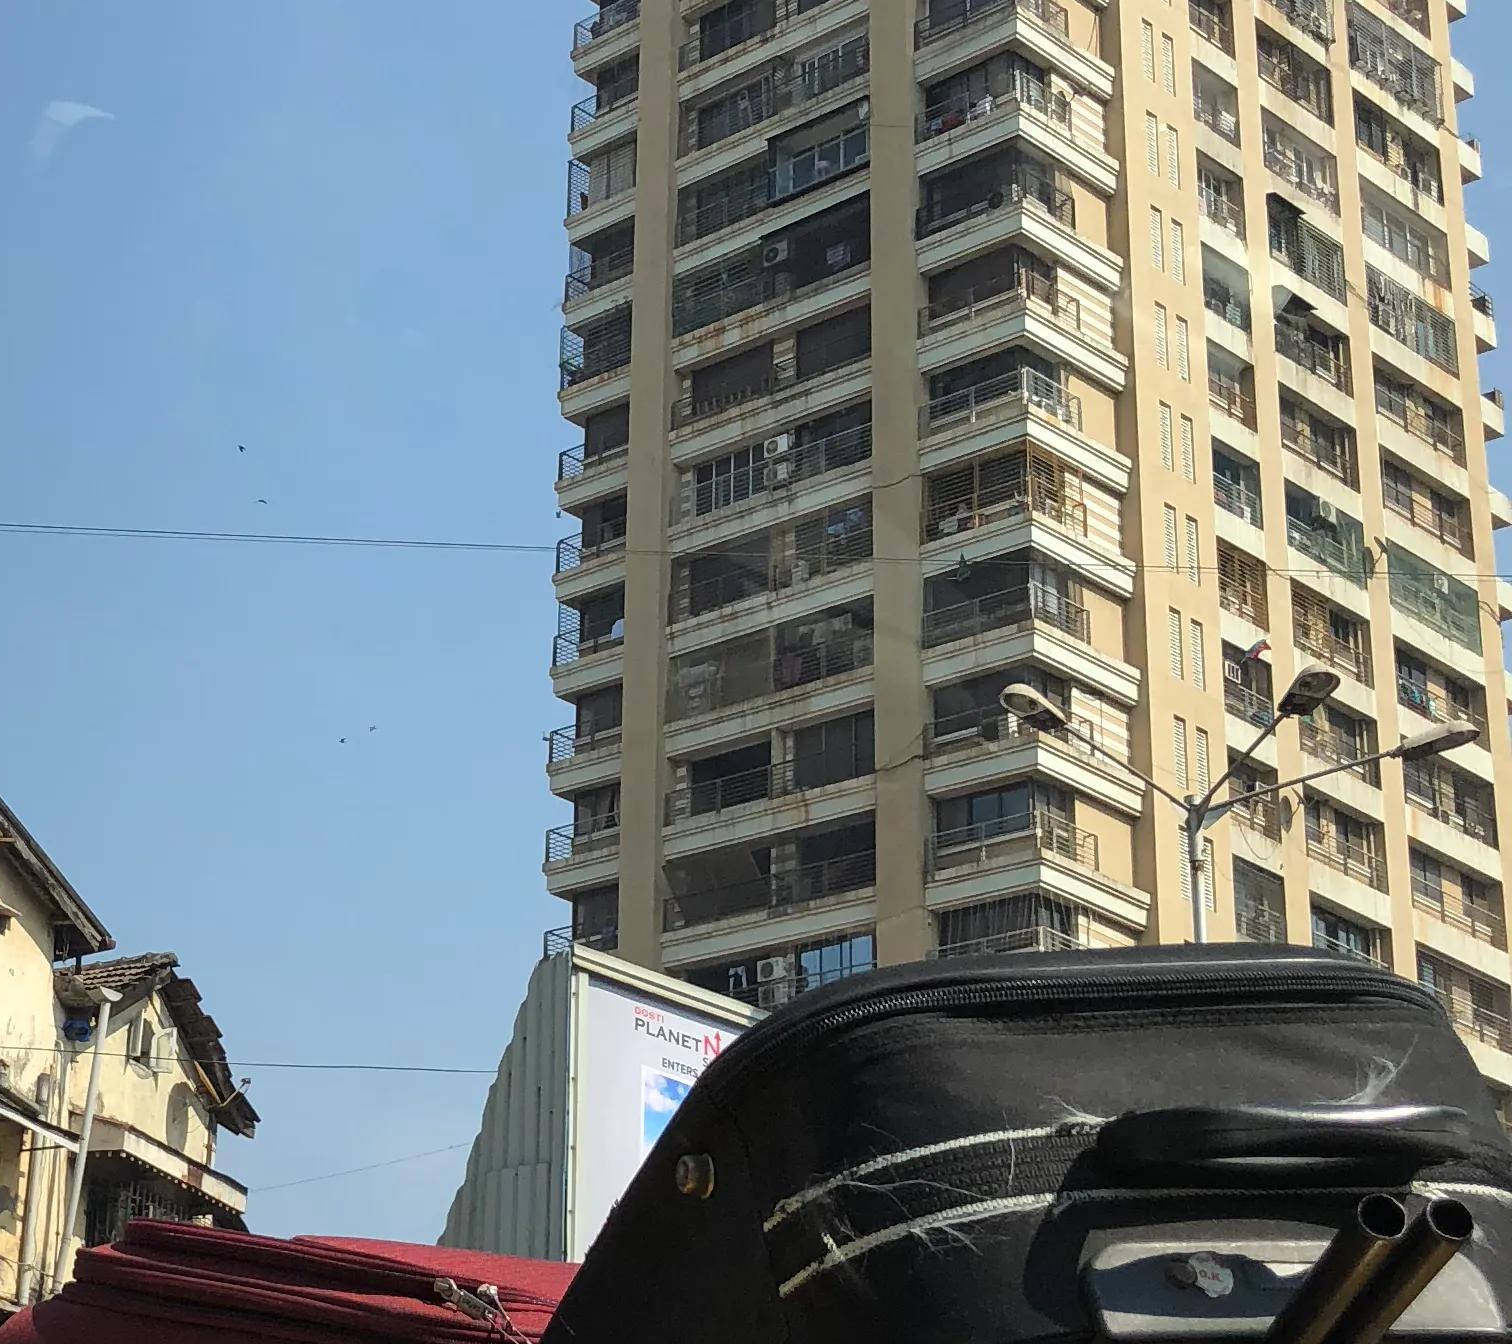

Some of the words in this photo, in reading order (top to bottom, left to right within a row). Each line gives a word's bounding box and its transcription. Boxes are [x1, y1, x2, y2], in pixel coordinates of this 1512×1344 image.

[634, 1006, 665, 1023] DOSTI
[634, 1017, 702, 1052] PLANET
[662, 1057, 699, 1078] ENTERS
